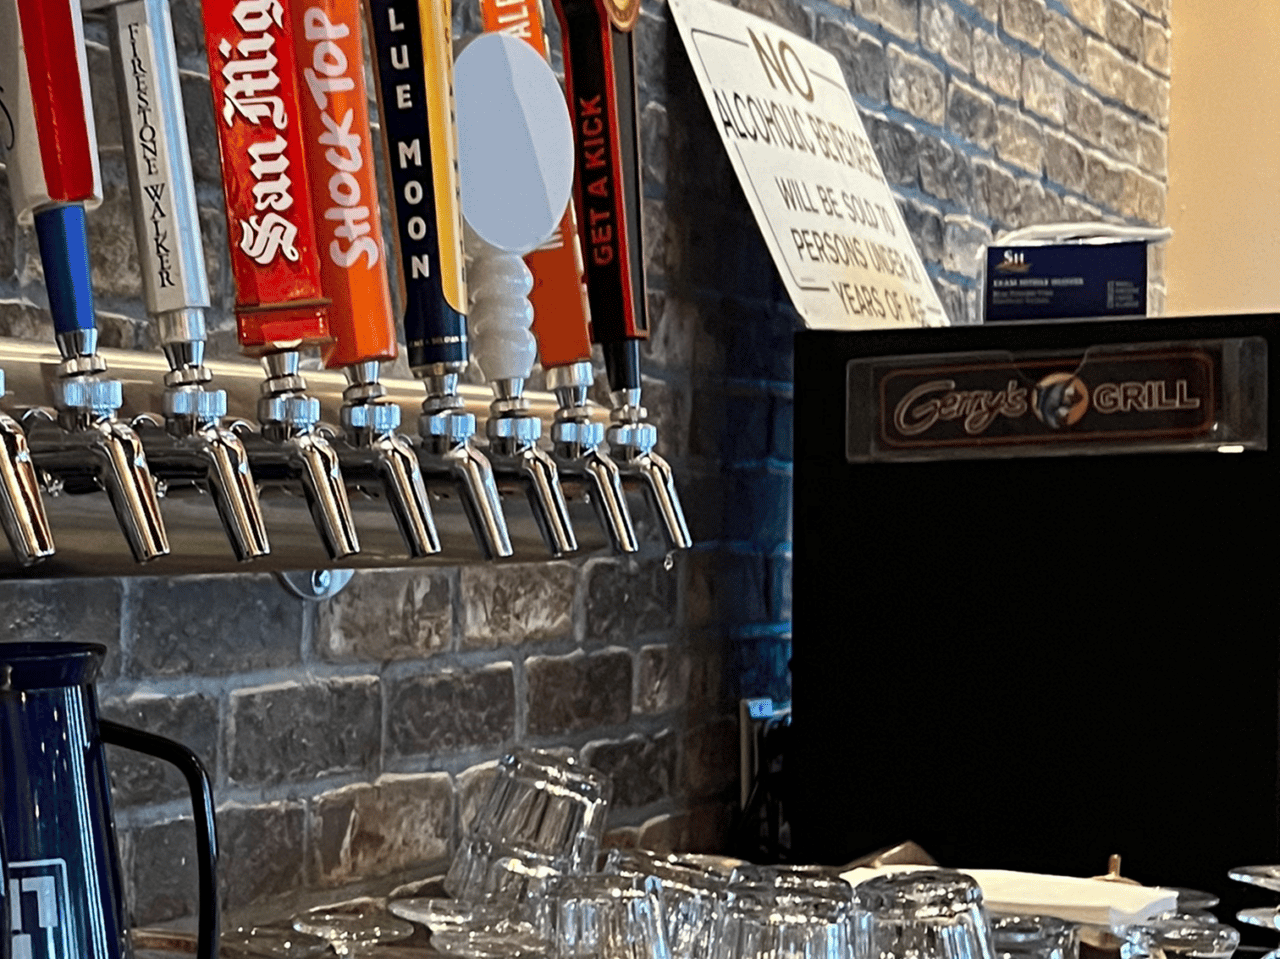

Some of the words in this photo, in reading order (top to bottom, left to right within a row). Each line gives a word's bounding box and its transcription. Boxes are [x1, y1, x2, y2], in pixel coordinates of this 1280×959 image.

[303, 6, 355, 110] TOP
[746, 26, 814, 104] NO
[128, 22, 157, 176] FIRESTONE
[144, 182, 175, 288] WALKER
[580, 94, 606, 170] KICK
[712, 88, 816, 156] ALCOHOLIC
[241, 134, 299, 265] San
[318, 107, 379, 270] SHOCK
[398, 138, 429, 279] MOON
[587, 175, 609, 198] A
[774, 176, 819, 213] WILL
[816, 184, 843, 218] BE
[841, 190, 878, 229] SOLD
[875, 203, 896, 236] TO
[589, 208, 613, 266] GET
[790, 227, 868, 269] PERSONS
[865, 239, 910, 280] UNDER
[831, 280, 886, 319] YEARS
[884, 288, 905, 322] OF
[894, 379, 1028, 436] Gerry's
[1093, 379, 1200, 414] GRILL
